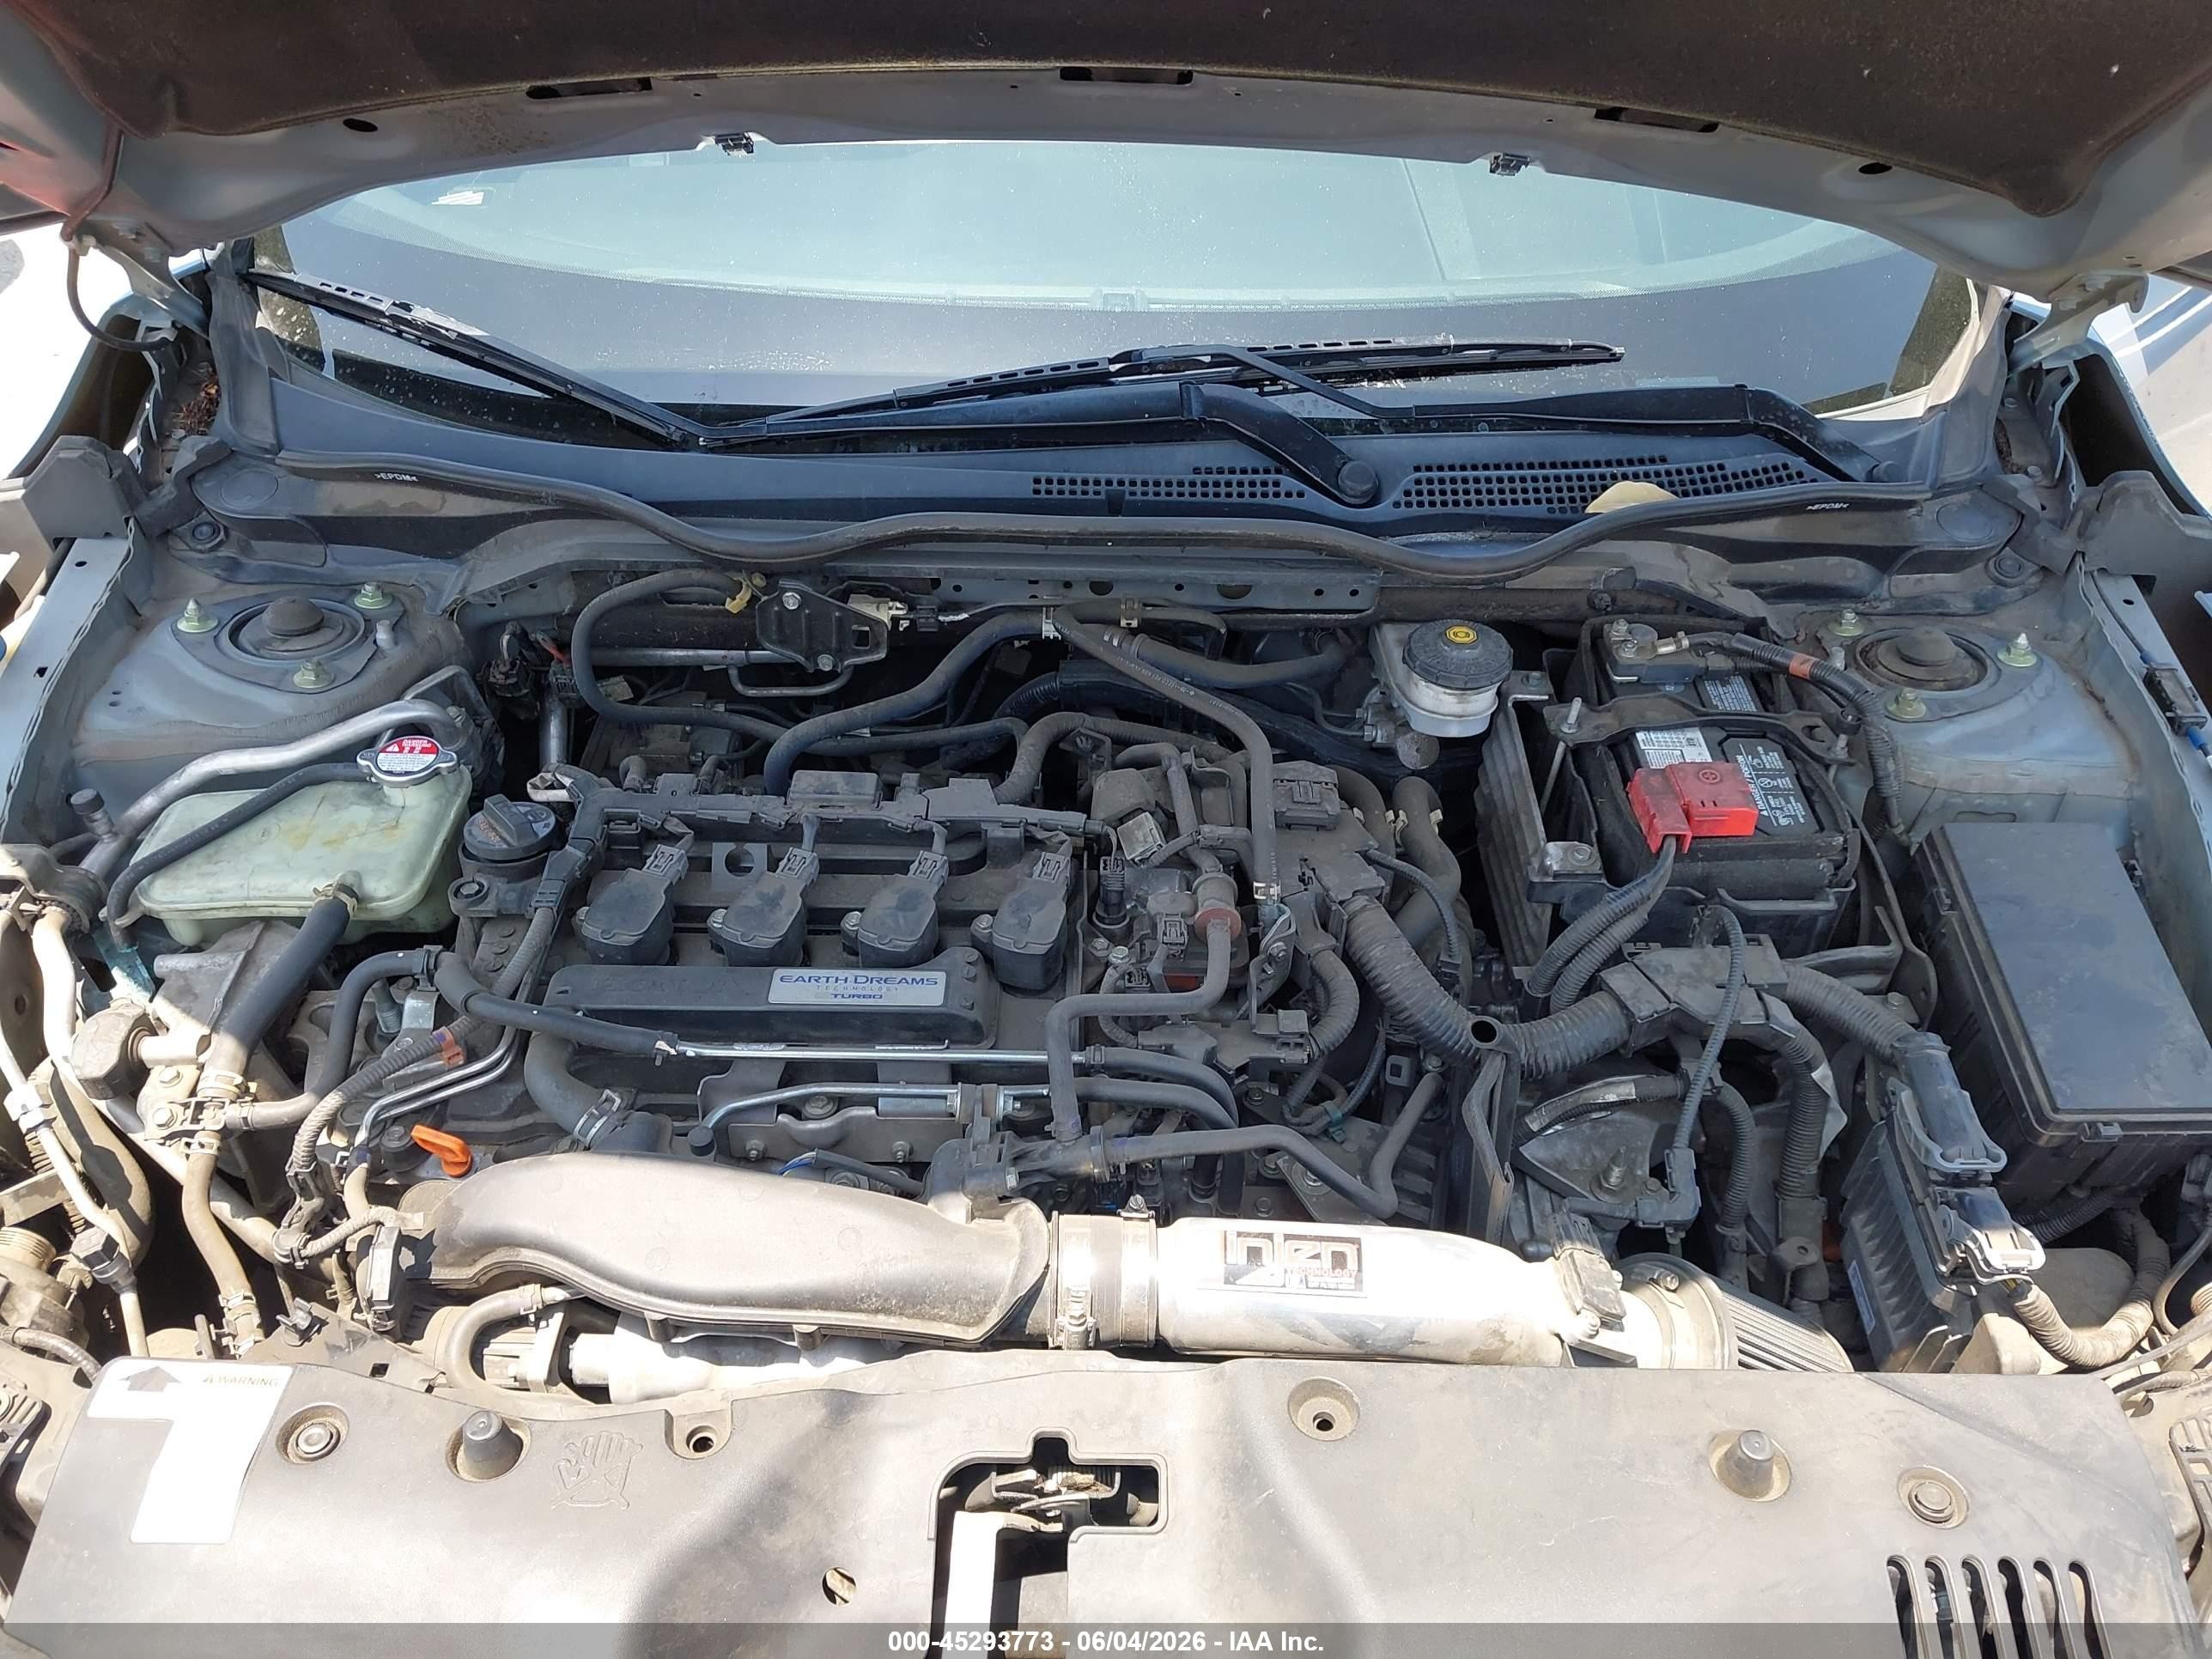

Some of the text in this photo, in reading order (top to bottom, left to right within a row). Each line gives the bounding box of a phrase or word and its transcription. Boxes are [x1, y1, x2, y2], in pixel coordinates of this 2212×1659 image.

[1735, 755, 1753, 778] POISON
[1747, 783, 1766, 810] DANGER
[779, 975, 939, 986] EARTH DREAMS
[218, 1376, 278, 1387] WARNING
